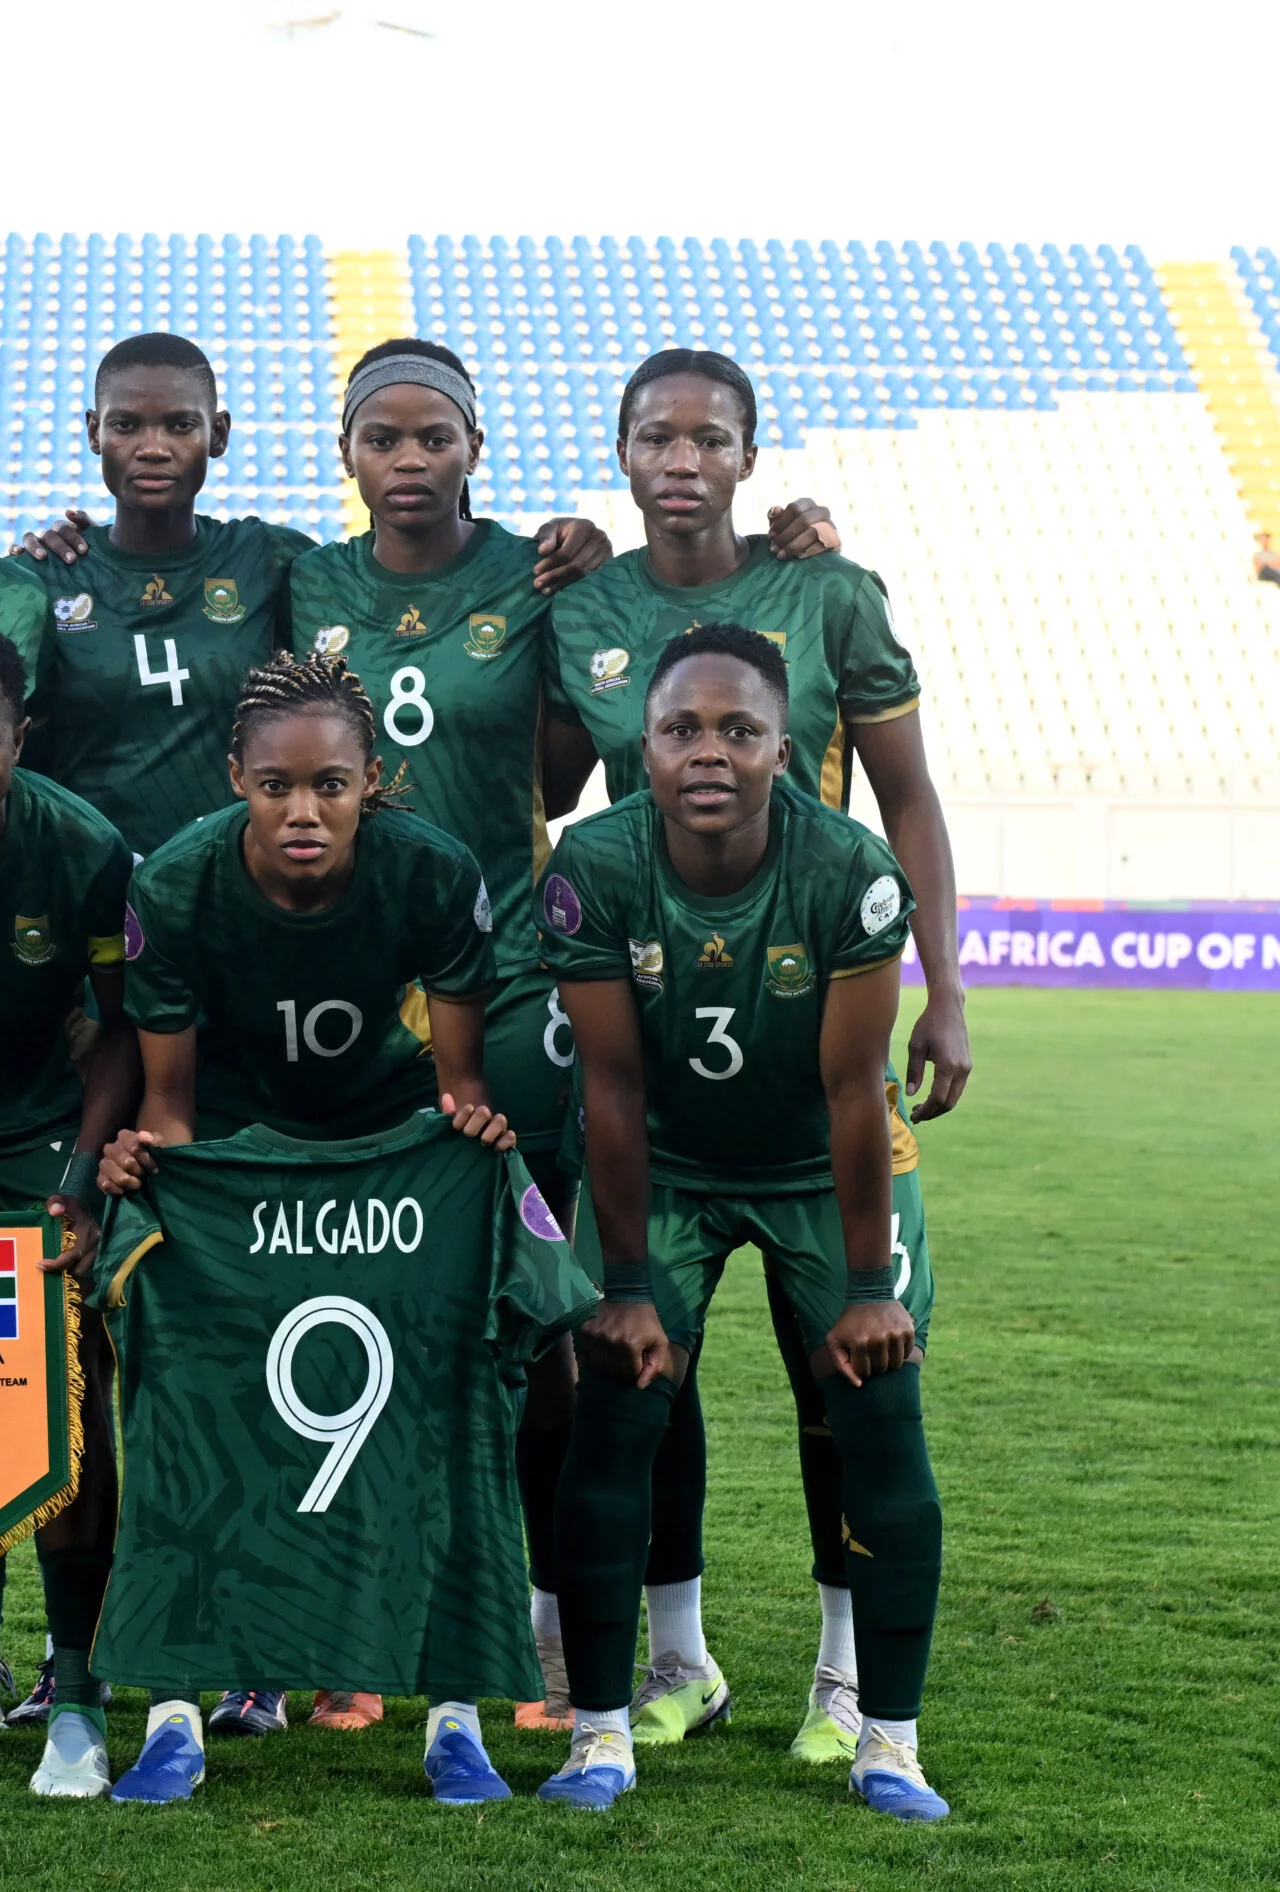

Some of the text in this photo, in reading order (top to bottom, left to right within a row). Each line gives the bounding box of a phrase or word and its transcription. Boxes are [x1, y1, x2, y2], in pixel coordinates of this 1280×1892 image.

[134, 634, 190, 706] 4
[384, 666, 434, 746] 8
[958, 930, 1106, 968] AFRICA
[1111, 931, 1192, 970] CUP
[1196, 933, 1256, 970] OF
[276, 999, 363, 1062] 10
[688, 1006, 744, 1080] 3
[250, 1196, 424, 1254] SALGADO
[0, 1378, 27, 1386] TEAM
[266, 1295, 394, 1512] 9
